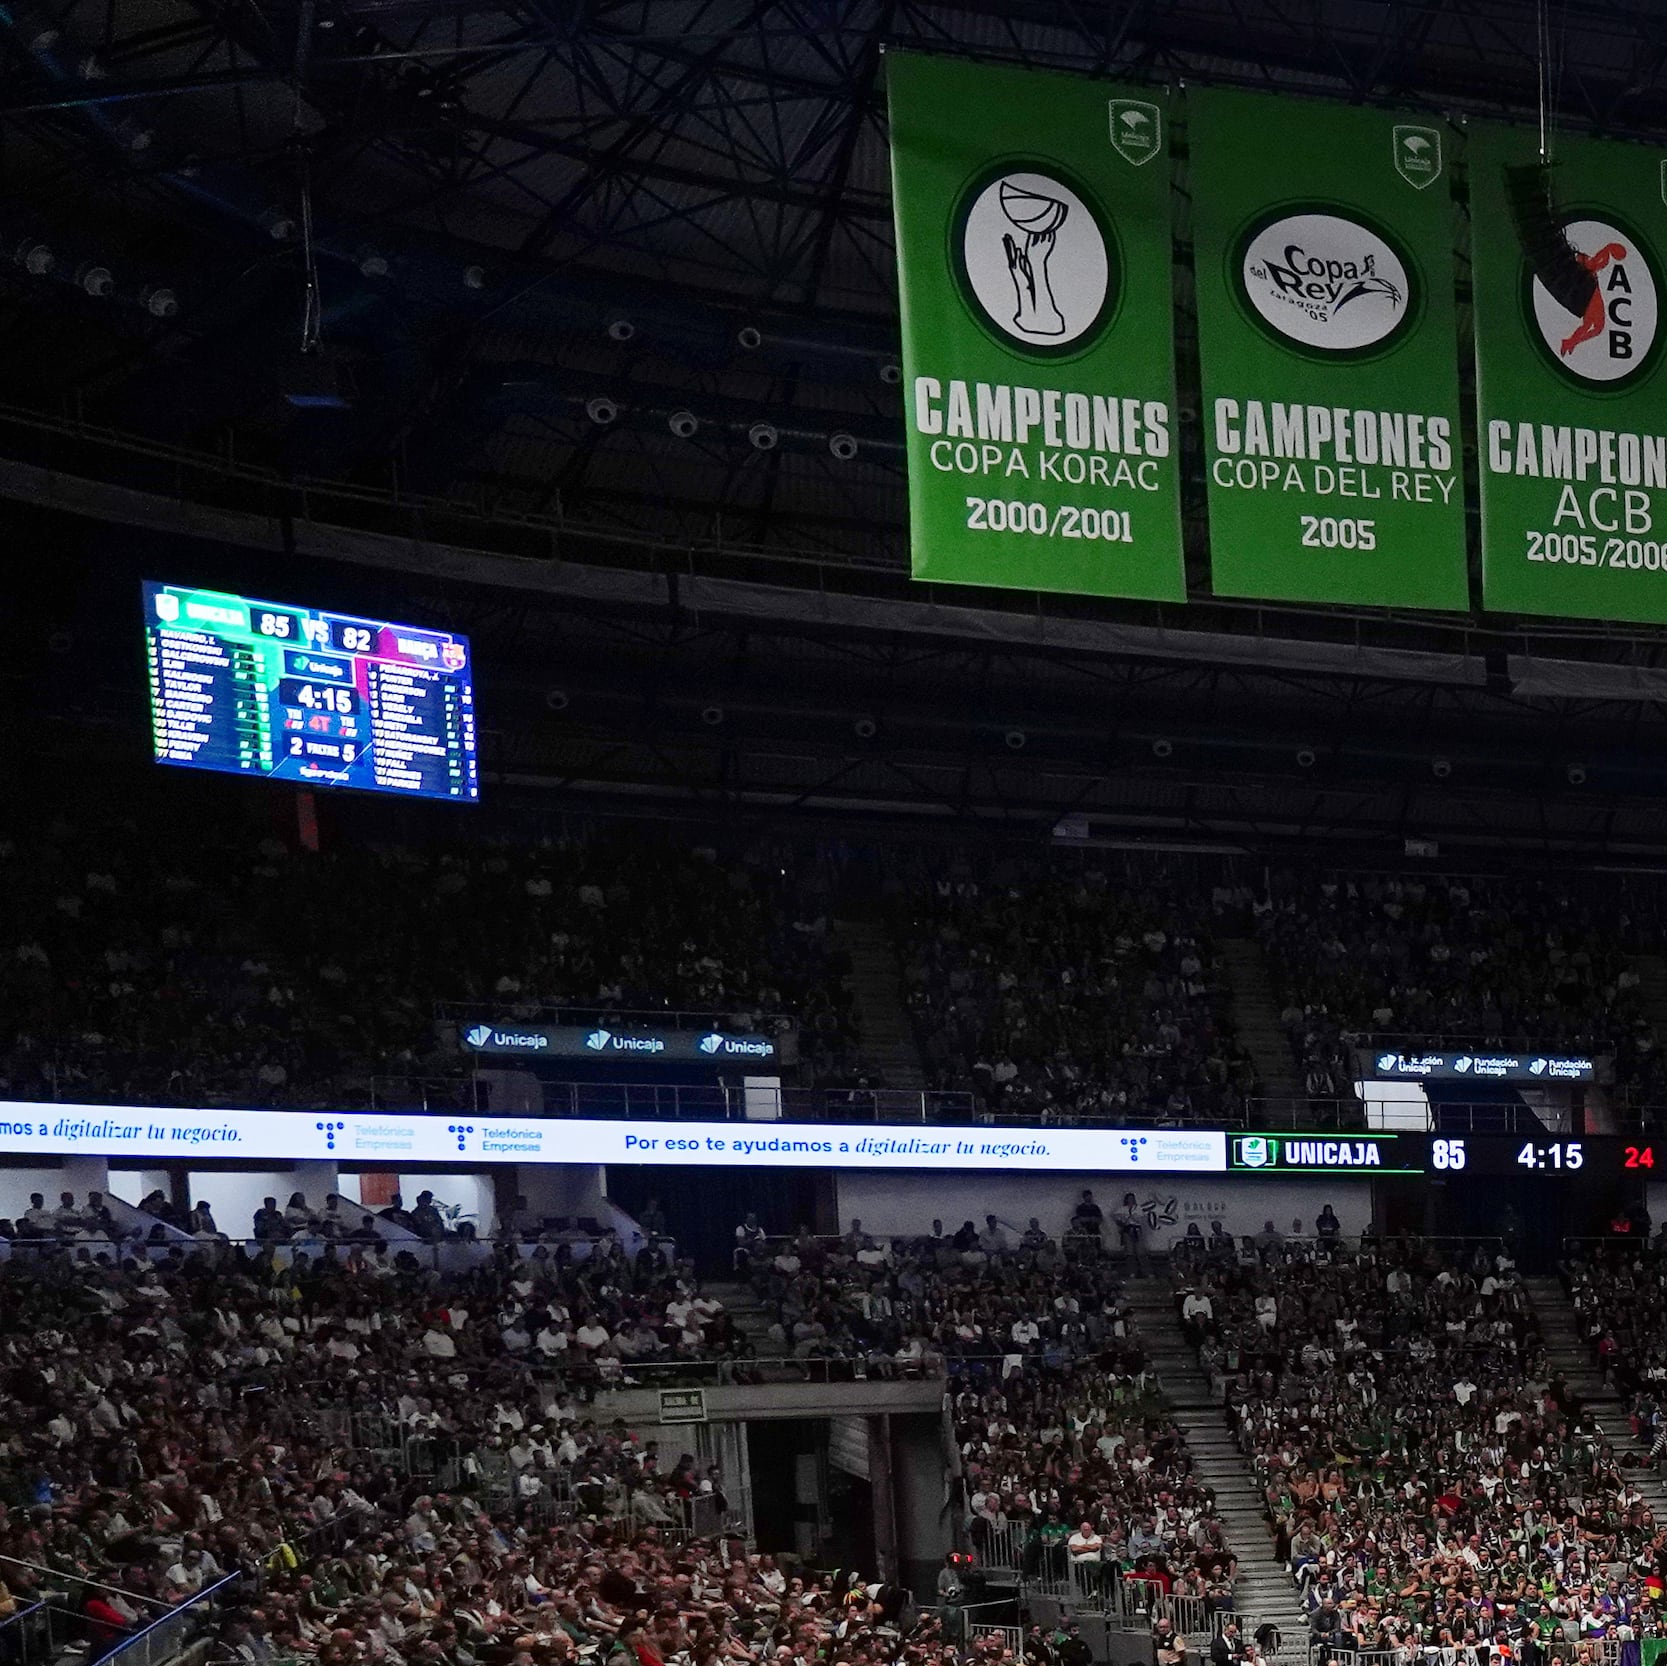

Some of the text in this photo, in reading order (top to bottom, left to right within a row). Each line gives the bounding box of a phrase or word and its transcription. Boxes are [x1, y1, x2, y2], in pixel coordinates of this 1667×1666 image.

[1262, 259, 1344, 304] Rey
[1284, 245, 1358, 283] Copa
[916, 377, 1170, 457] CAMPEONES
[1214, 398, 1452, 471] CAMPEONES
[930, 440, 1160, 491] COPA KORAC
[1213, 457, 1457, 505] COPA DEL REY
[966, 497, 1134, 543] 2000/2001
[1553, 484, 1653, 534] ACB
[1301, 515, 1376, 550] 2005
[260, 613, 371, 651] 85 VS 82
[298, 684, 352, 714] 4:15
[494, 1032, 774, 1057] Unicaja Unicaja Unicaja
[52, 1117, 243, 1146] digitalizar negocio.
[481, 1127, 543, 1141] Telefónica
[481, 1140, 542, 1154] Empresas
[624, 1134, 1052, 1159] Por eso te ayudamos digitalizar tu negocio.
[1285, 1143, 1381, 1167] UNICAJA
[1432, 1140, 1466, 1170] 85
[1517, 1142, 1584, 1170] 4:15
[1624, 1147, 1655, 1169] 24
